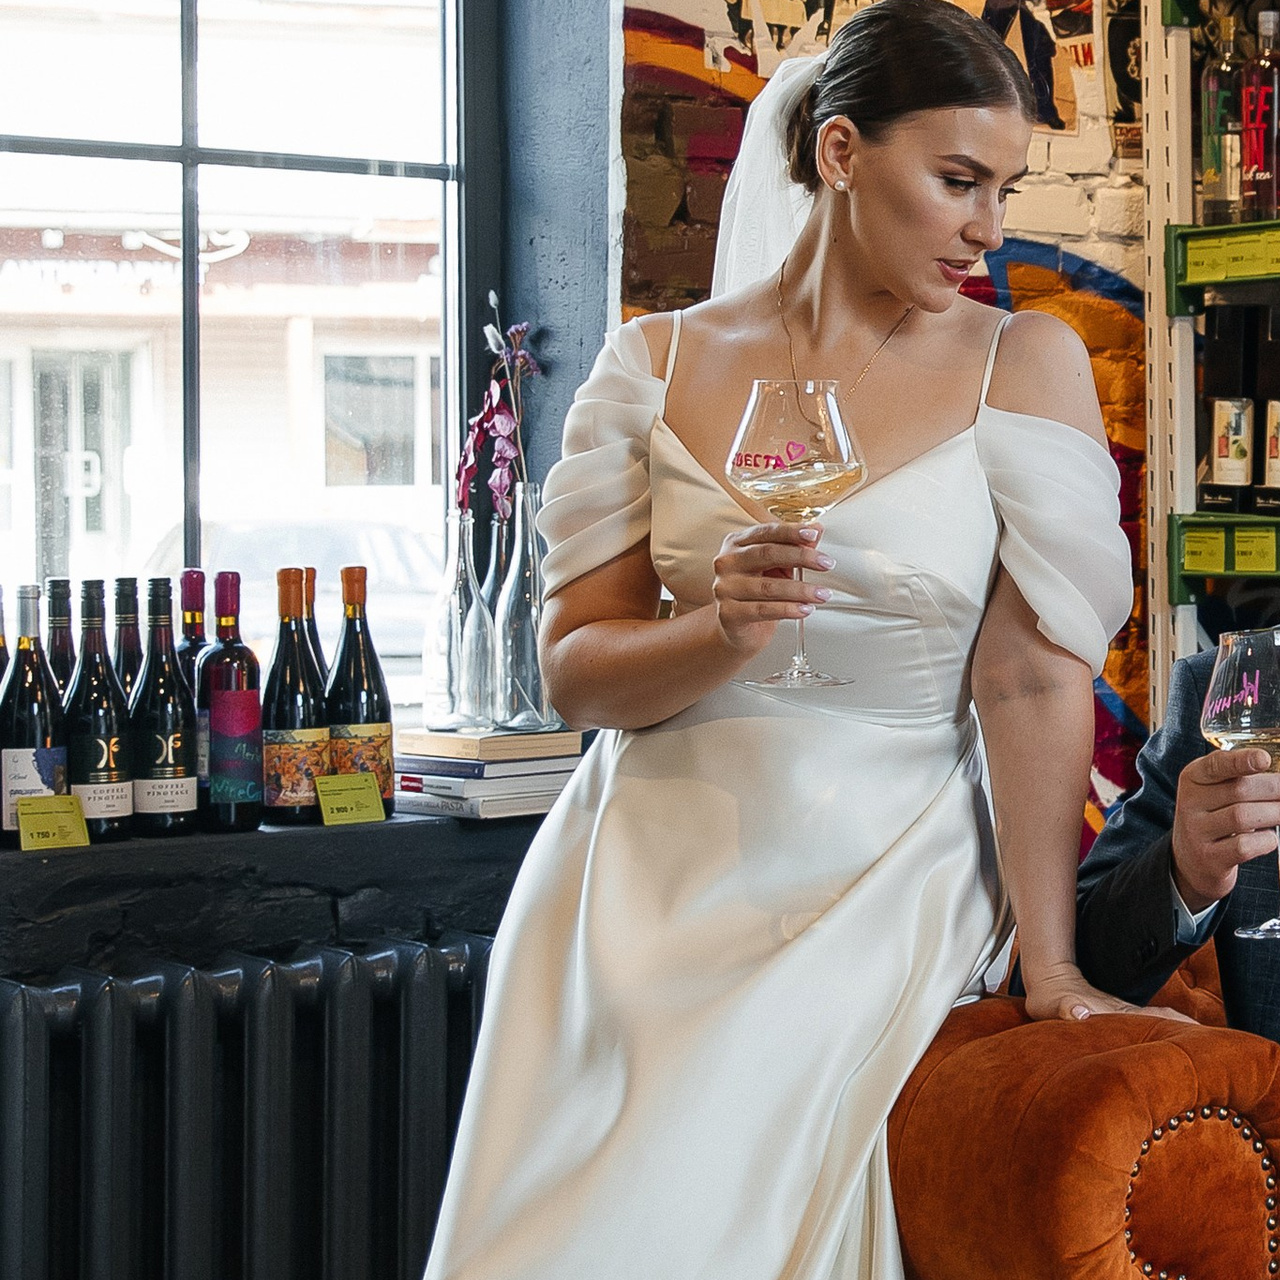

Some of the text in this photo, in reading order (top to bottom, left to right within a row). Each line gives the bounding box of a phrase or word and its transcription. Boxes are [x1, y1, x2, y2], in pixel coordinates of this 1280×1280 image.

[93, 787, 125, 795] COFFEE
[152, 783, 185, 791] COFFEE
[146, 789, 189, 797] PINOTAGE
[87, 793, 128, 802] PINOTAGE
[440, 800, 465, 813] PASTA
